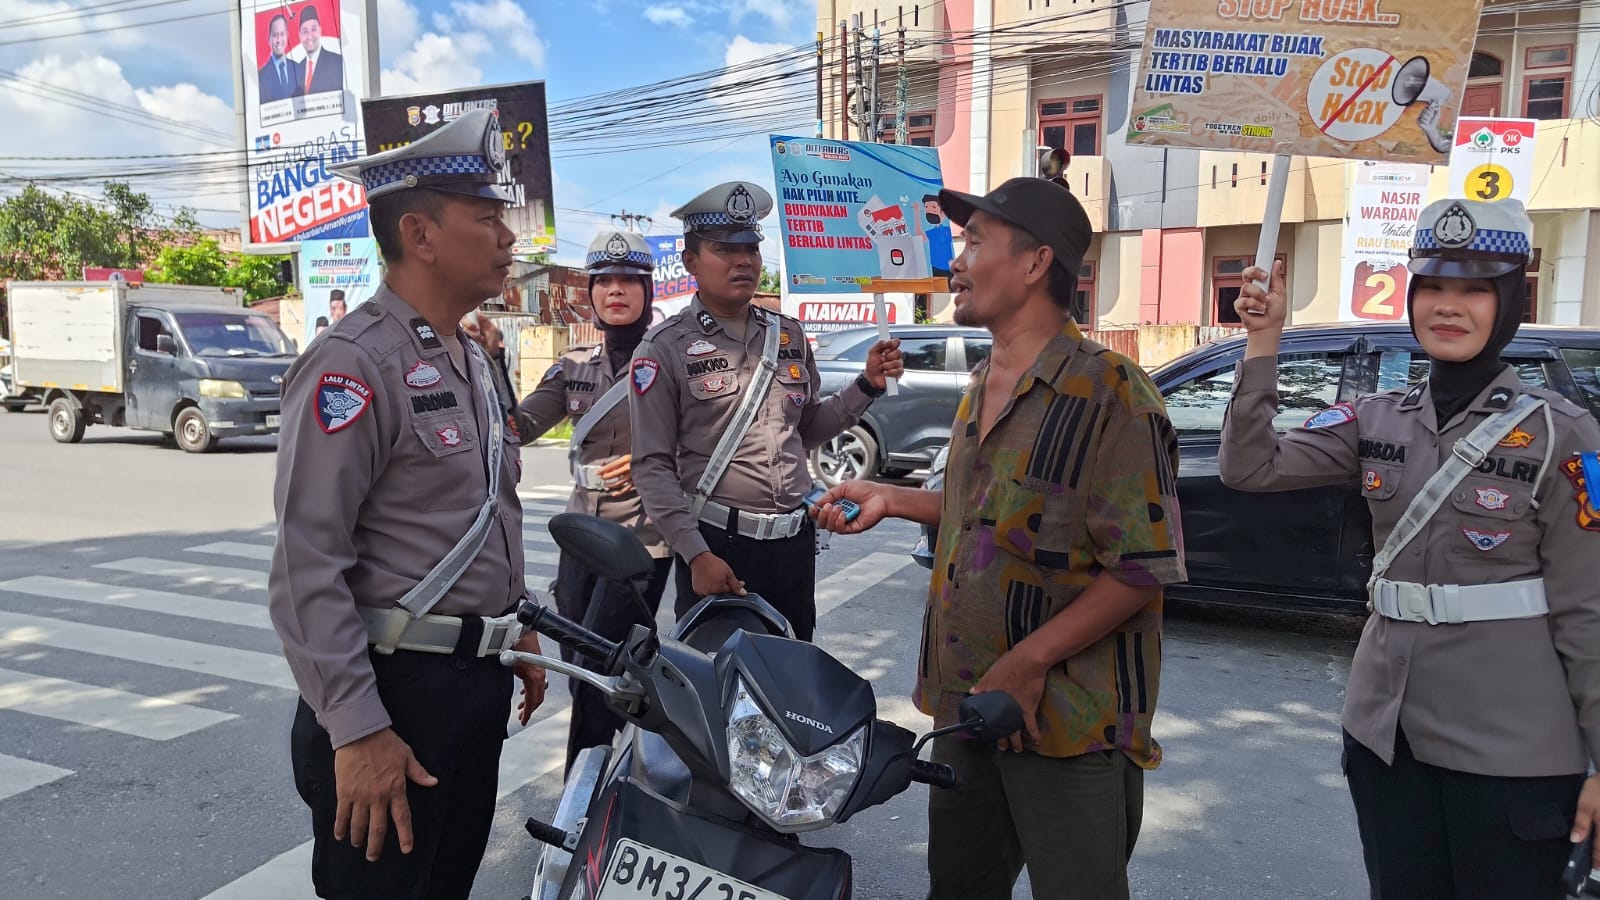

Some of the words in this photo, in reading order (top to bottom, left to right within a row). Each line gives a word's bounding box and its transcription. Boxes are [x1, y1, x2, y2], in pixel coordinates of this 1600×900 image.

[1154, 29, 1269, 52] MASYARAKAT
[1270, 35, 1325, 57] BIJAK,
[1151, 52, 1208, 71] TERTIB
[1211, 55, 1288, 77] BERLALU
[1329, 56, 1393, 92] Stop
[1145, 73, 1204, 94] LINTAS
[1319, 92, 1389, 126] Hoax
[1241, 125, 1273, 137] STRONG
[1500, 146, 1521, 154] PKS
[257, 140, 358, 210] BANGUN
[780, 168, 809, 187] Ayo
[812, 170, 873, 190] Gunakan
[782, 187, 804, 201] HAK
[1475, 171, 1500, 199] 3
[1380, 191, 1420, 205] NASIR
[257, 180, 363, 243] NEGERI
[784, 203, 849, 218] BUDAYAKAN
[1360, 206, 1419, 221] WARDAN
[786, 219, 825, 233] TERTIB
[1381, 222, 1415, 238] Untuk
[788, 235, 835, 249] BERLALU
[837, 236, 873, 250] LINTAS
[1357, 236, 1384, 249] RIAU
[1384, 238, 1413, 251] EMAS
[1361, 273, 1396, 316] 2
[778, 348, 802, 360] OLRI
[345, 379, 370, 396] LINTAS
[1477, 456, 1539, 483] OLRI
[784, 710, 834, 735] HONDA
